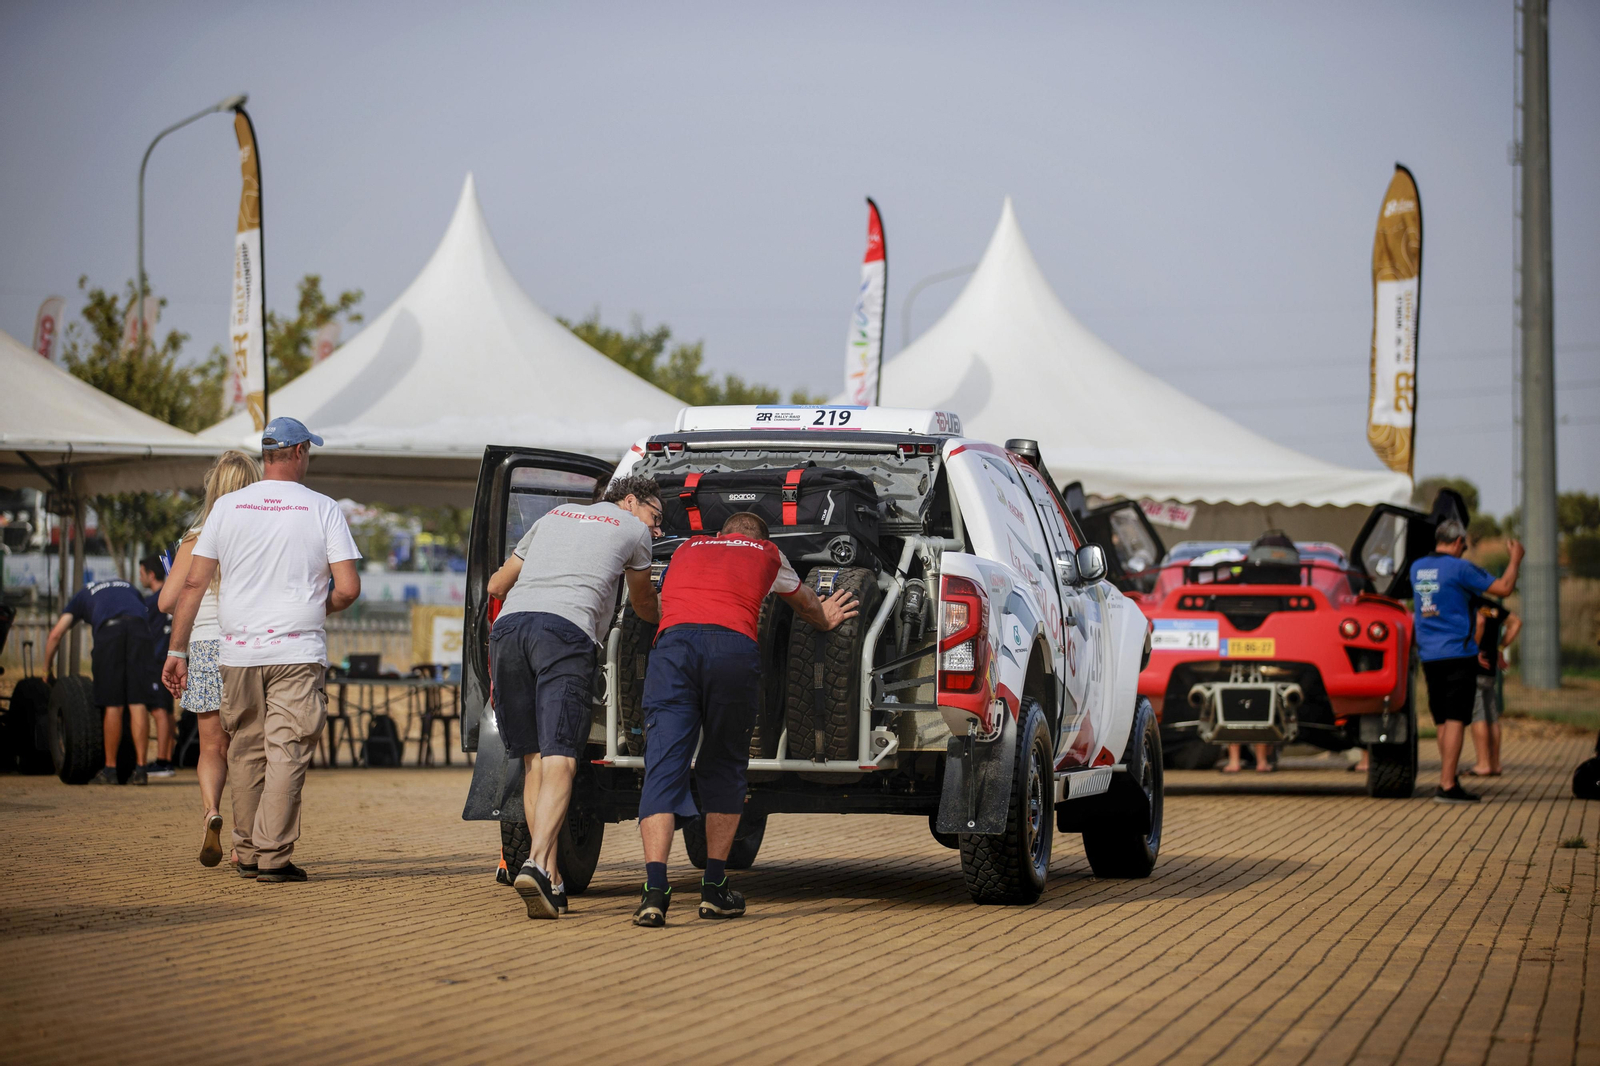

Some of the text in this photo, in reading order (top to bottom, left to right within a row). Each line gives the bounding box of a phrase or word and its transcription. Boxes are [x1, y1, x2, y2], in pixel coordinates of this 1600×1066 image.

[756, 410, 851, 426] 2R 219
[235, 503, 309, 513] andaluciarallyodc.com
[1187, 632, 1210, 648] 216
